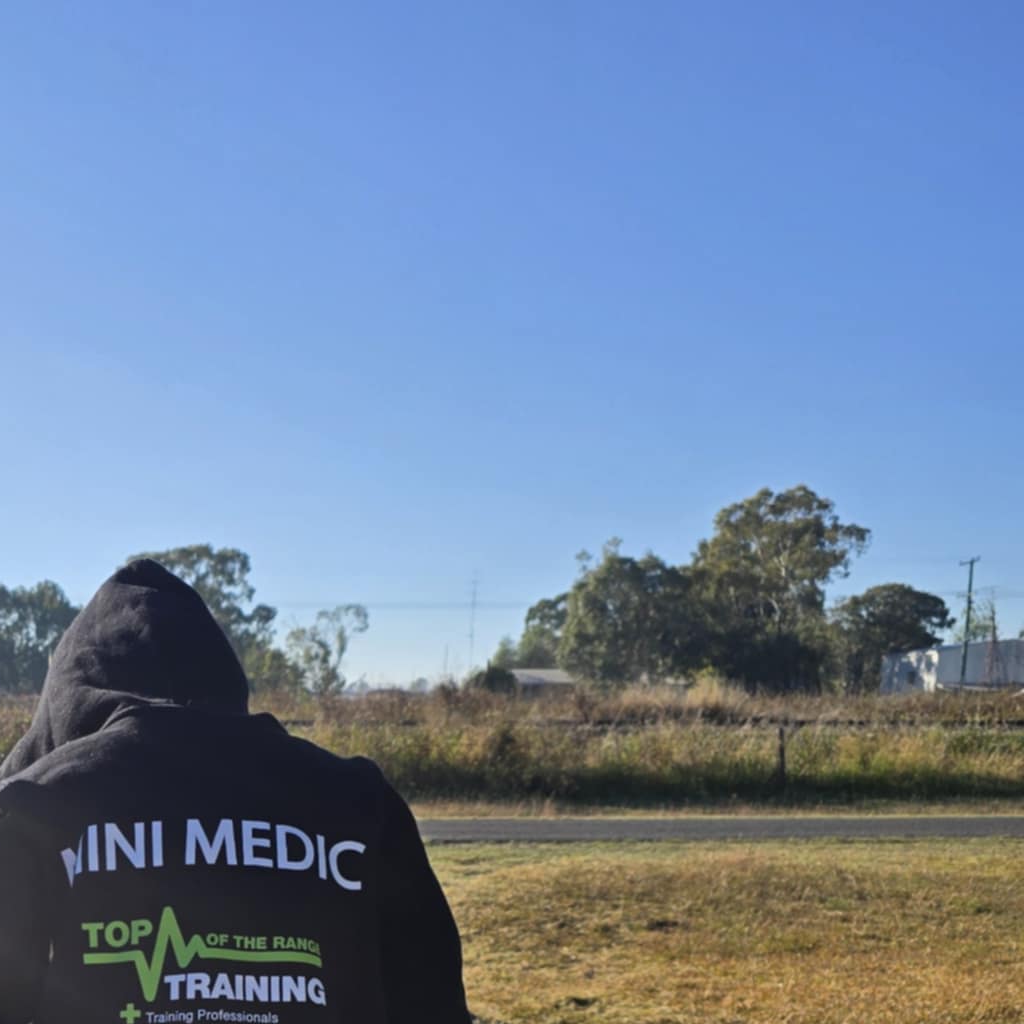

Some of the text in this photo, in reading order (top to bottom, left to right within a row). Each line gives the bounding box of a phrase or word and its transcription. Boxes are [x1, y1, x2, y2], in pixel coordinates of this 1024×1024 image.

[184, 818, 366, 891] MEDIC
[81, 920, 152, 948] TOP
[206, 933, 228, 946] OF
[233, 935, 267, 949] THE
[164, 972, 326, 1005] TRAINING
[145, 1009, 278, 1024] Training Professionals
